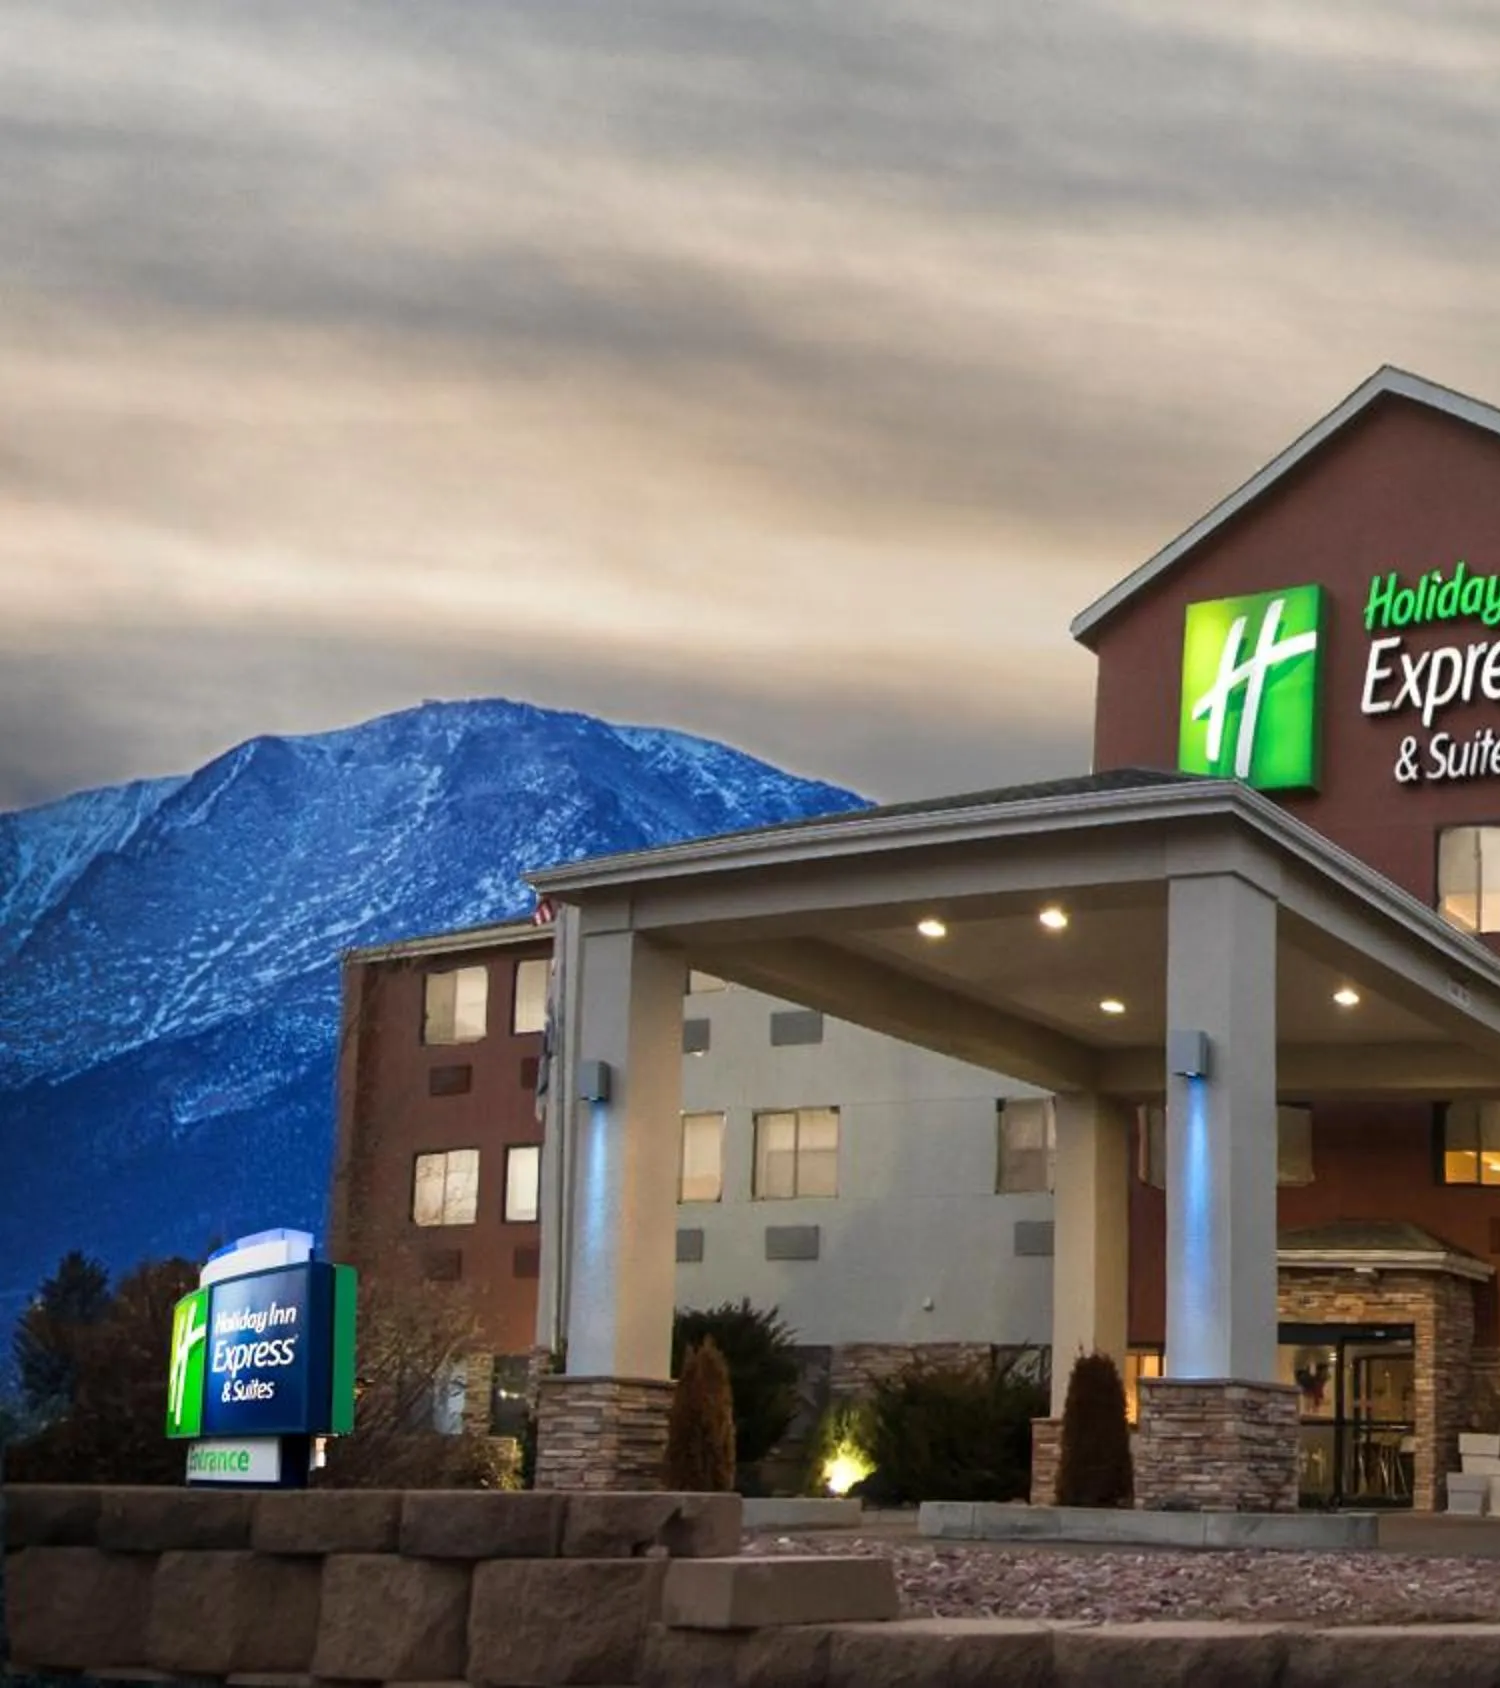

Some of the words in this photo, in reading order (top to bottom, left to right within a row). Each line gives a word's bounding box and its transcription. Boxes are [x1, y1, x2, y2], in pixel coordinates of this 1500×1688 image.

[1394, 736, 1418, 783] &
[216, 1308, 267, 1337] Holiday
[269, 1302, 297, 1326] Inn
[212, 1337, 296, 1378] Express
[221, 1383, 232, 1403] &
[232, 1378, 275, 1402] Suites
